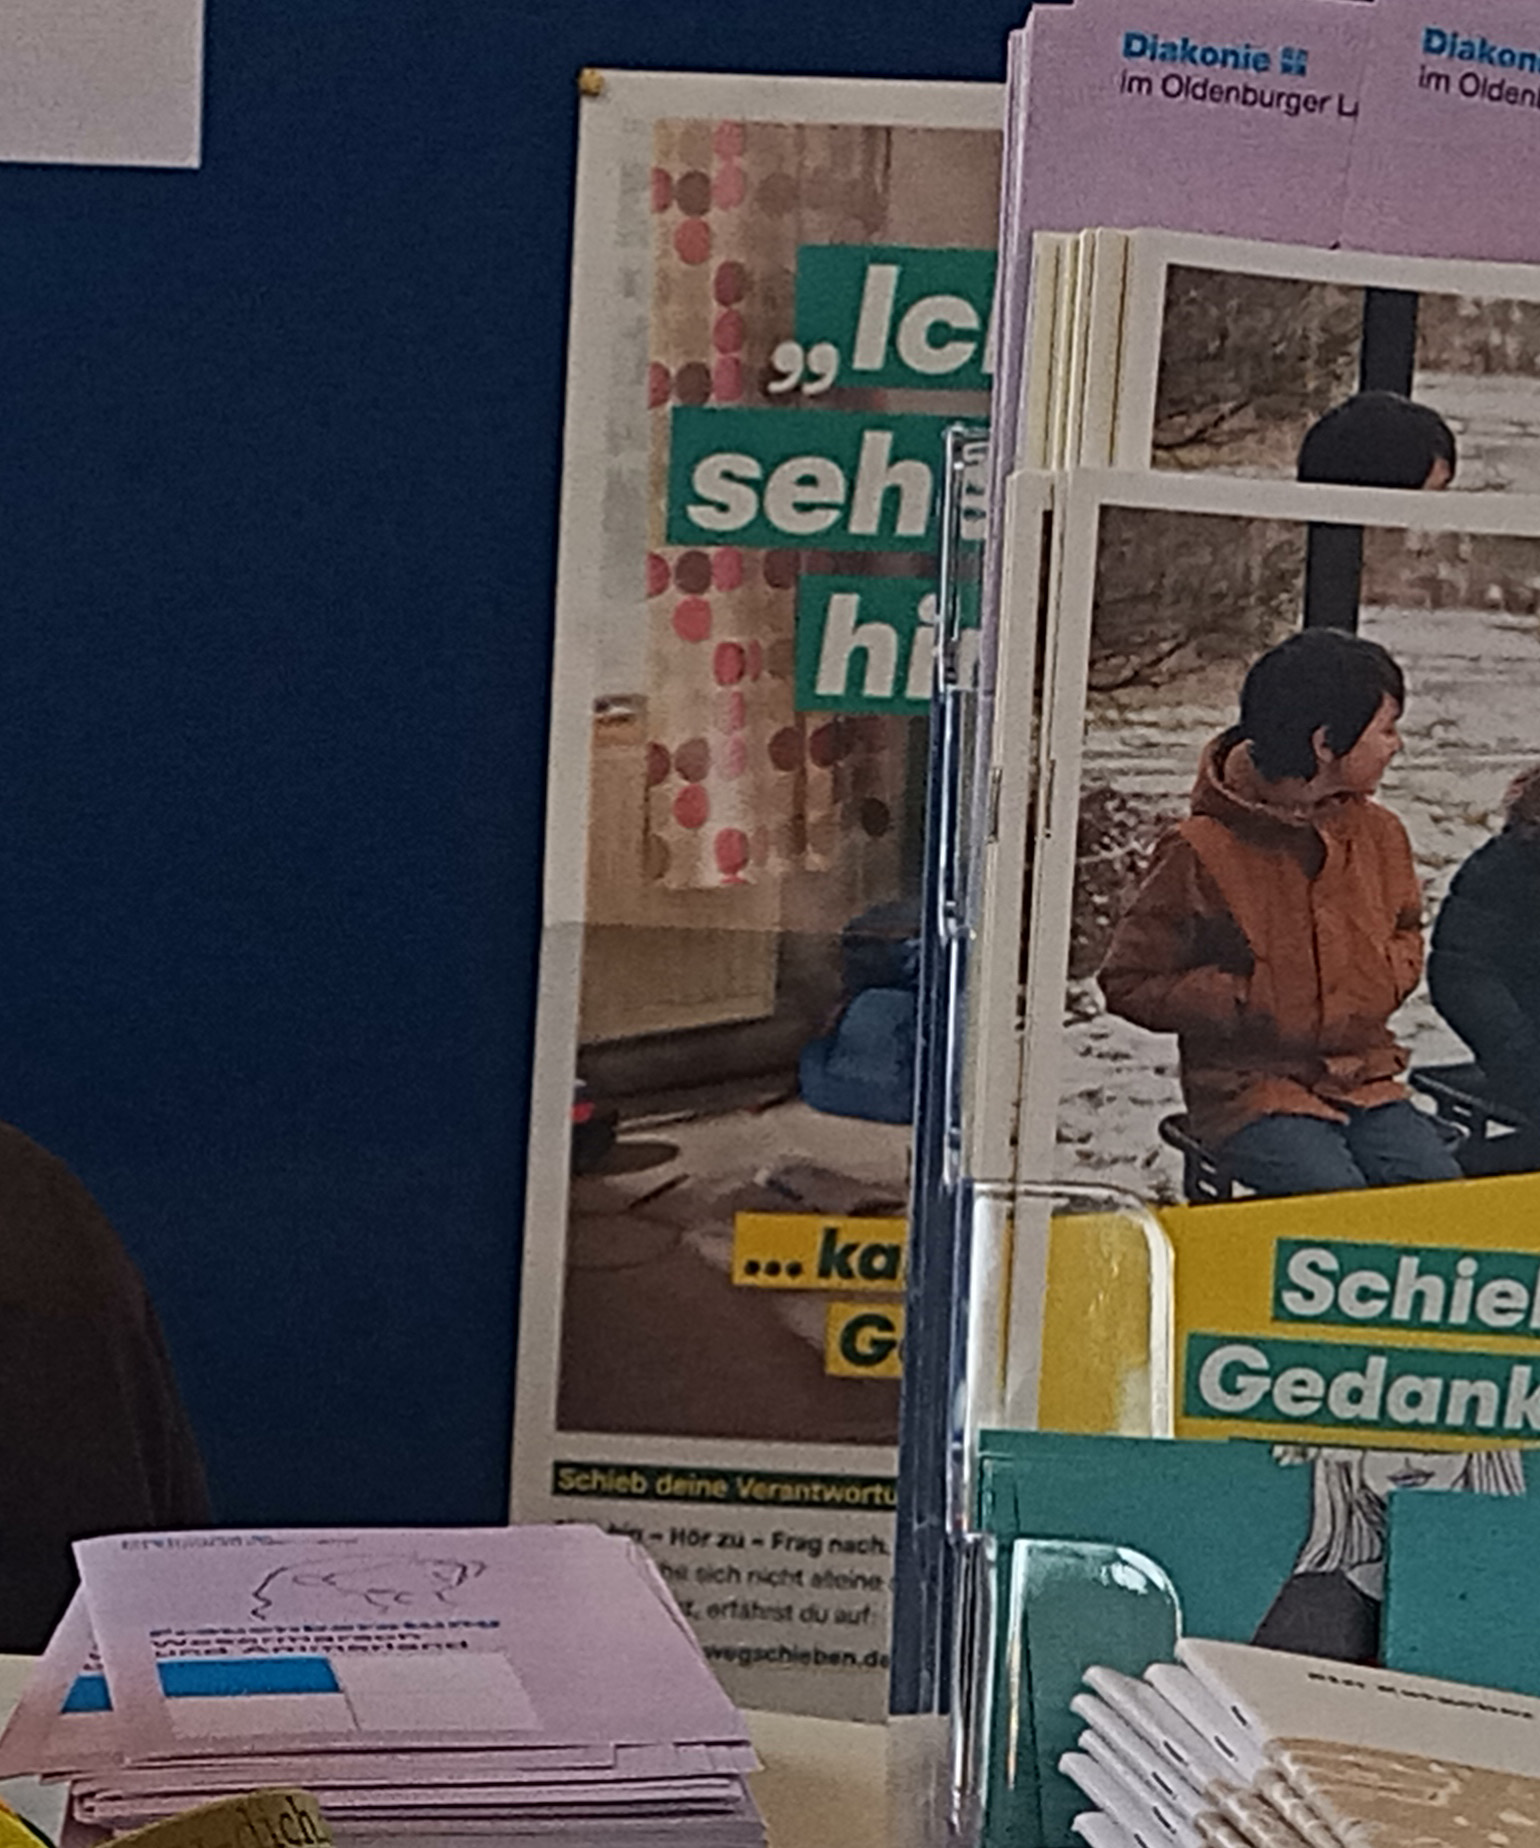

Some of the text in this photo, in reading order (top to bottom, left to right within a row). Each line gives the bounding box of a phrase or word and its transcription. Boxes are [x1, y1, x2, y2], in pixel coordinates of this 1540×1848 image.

[1122, 31, 1272, 74] Diakonie
[1421, 28, 1540, 74] Diakon
[1120, 68, 1153, 97] im
[1160, 73, 1331, 118] Oldenburger
[1417, 66, 1540, 111] im Olden
[768, 263, 998, 394] „Ic
[818, 1229, 905, 1280] ka
[1199, 1344, 1540, 1432] Gedank
[558, 1468, 897, 1504] Schieb deine Verantwortu
[670, 1527, 712, 1548] Hör
[716, 1531, 745, 1548] zu
[772, 1531, 823, 1557] Frag
[799, 1603, 829, 1625] du
